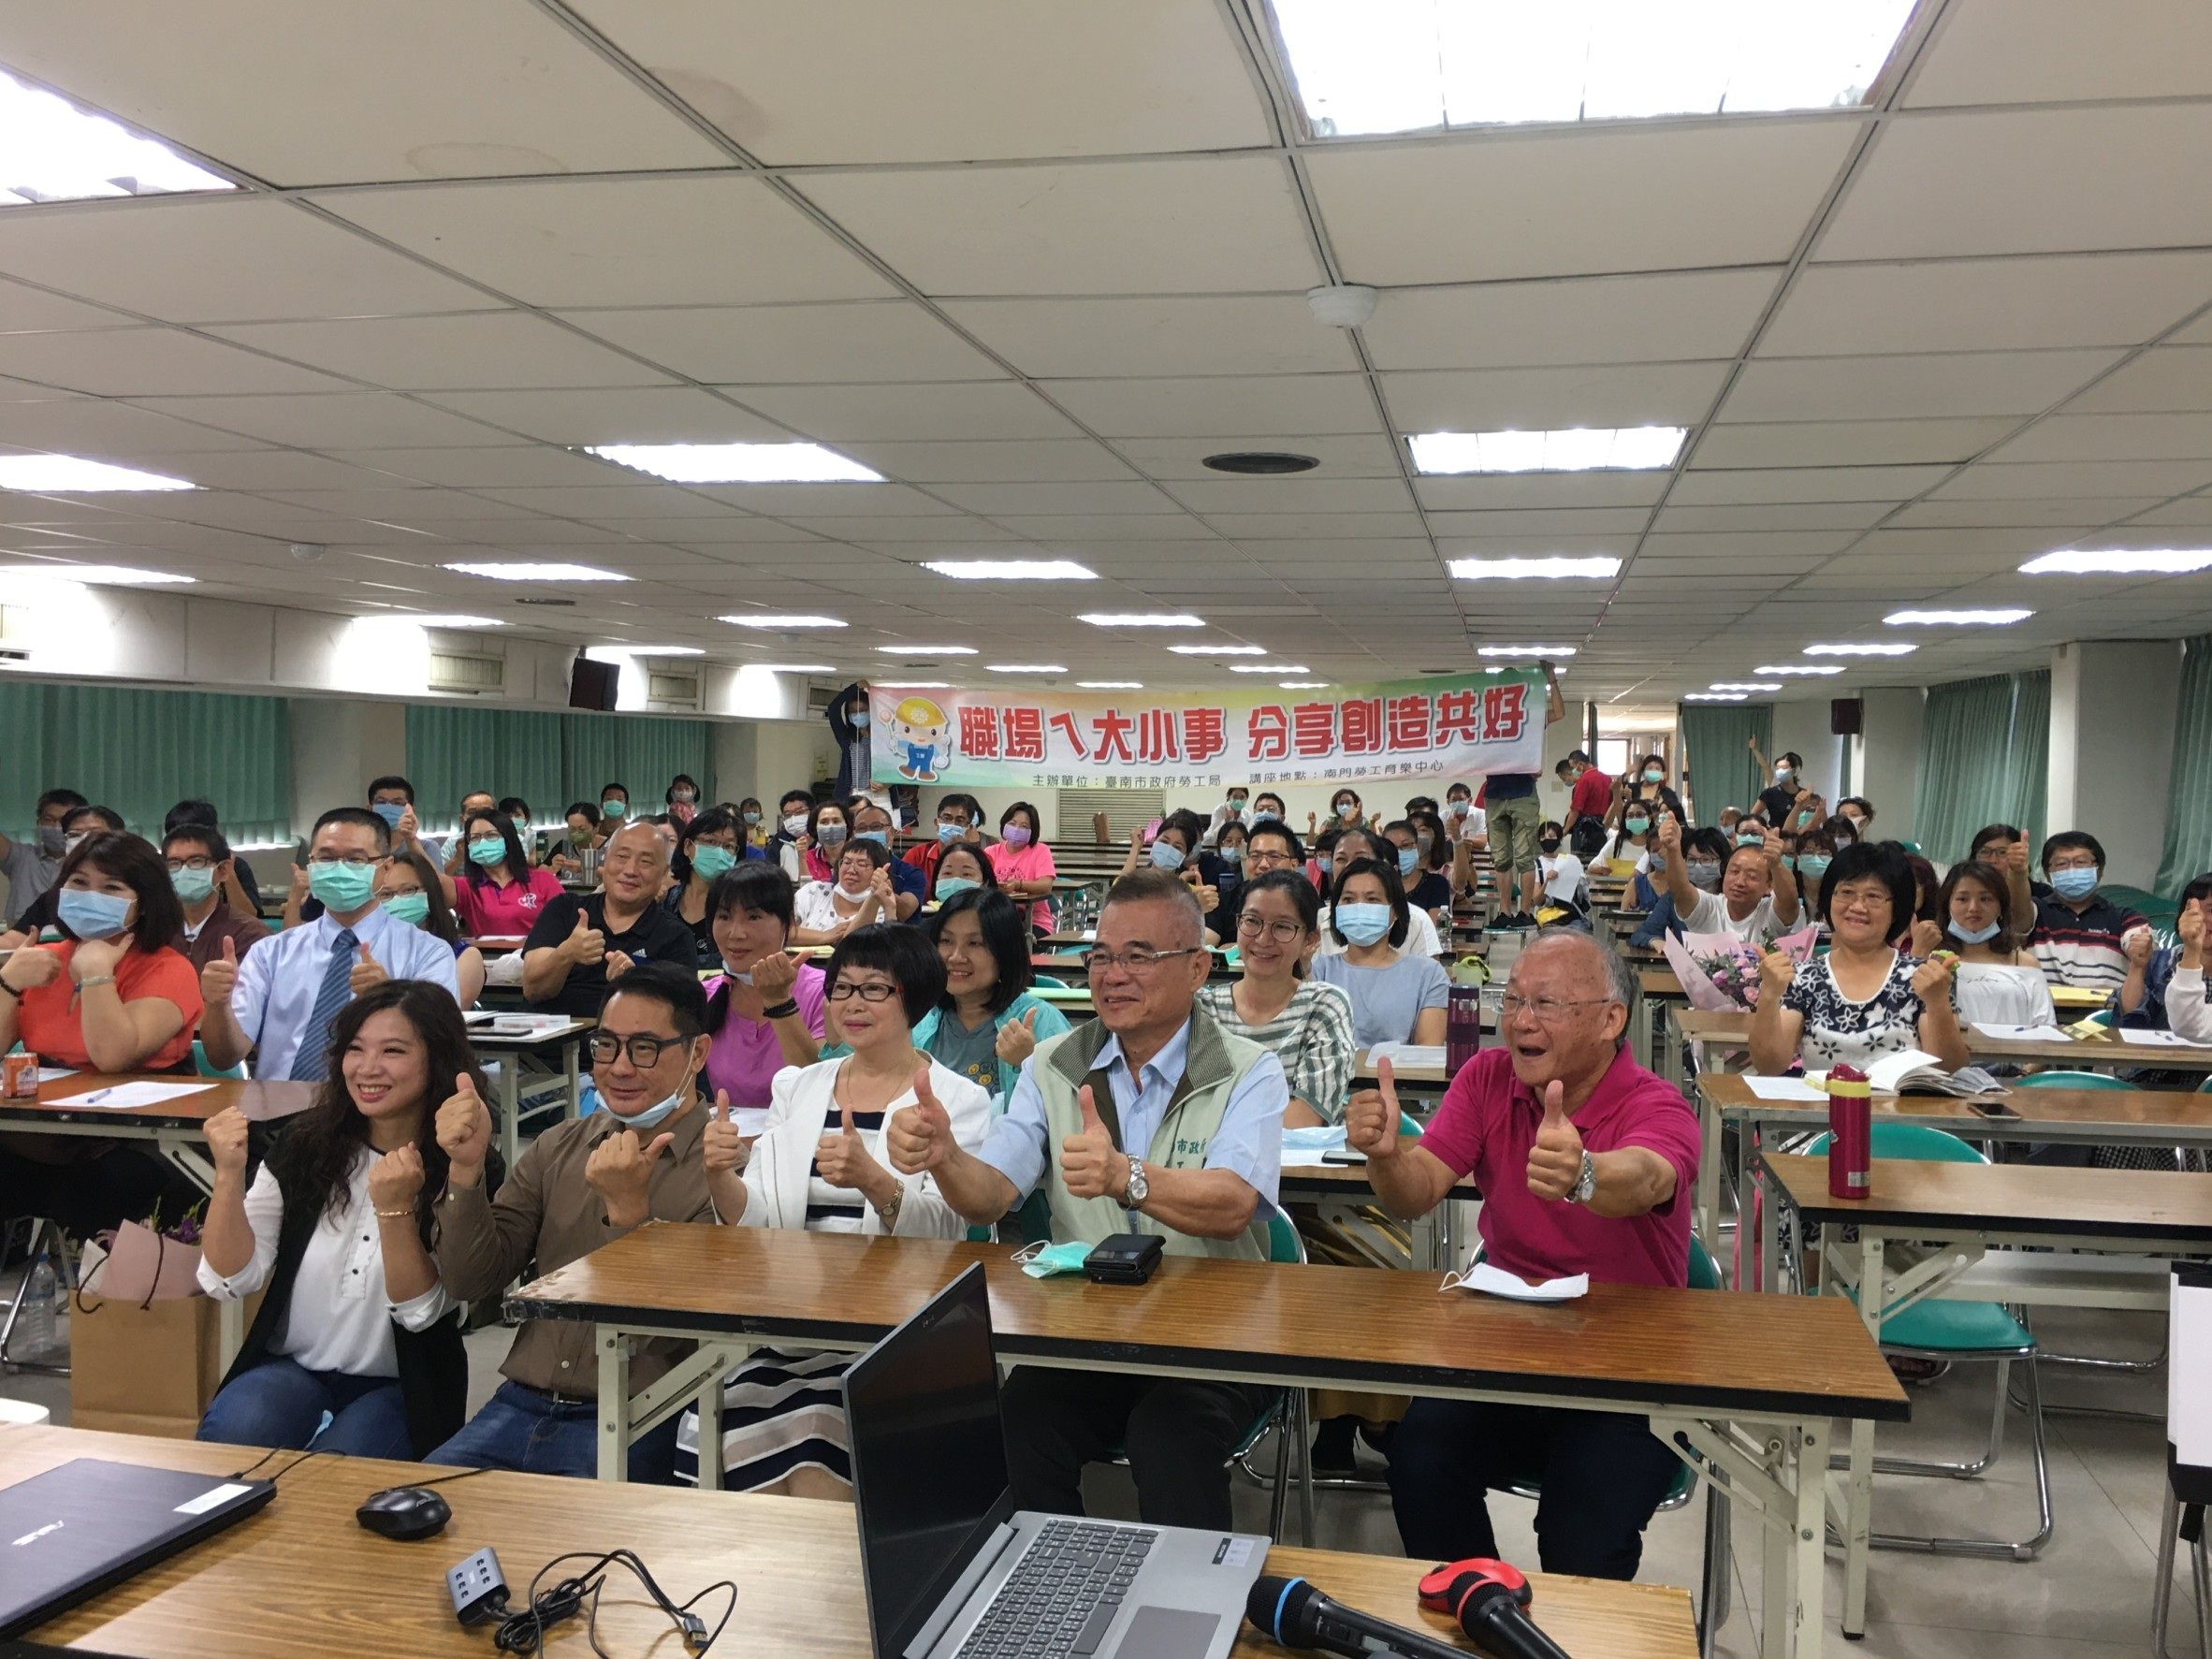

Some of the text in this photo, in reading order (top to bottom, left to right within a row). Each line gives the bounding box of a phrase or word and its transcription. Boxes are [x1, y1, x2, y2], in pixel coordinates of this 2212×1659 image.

[1247, 684, 1530, 759] 分享創造共好
[1249, 759, 1444, 784] 講座地點：南門勞工育樂中心
